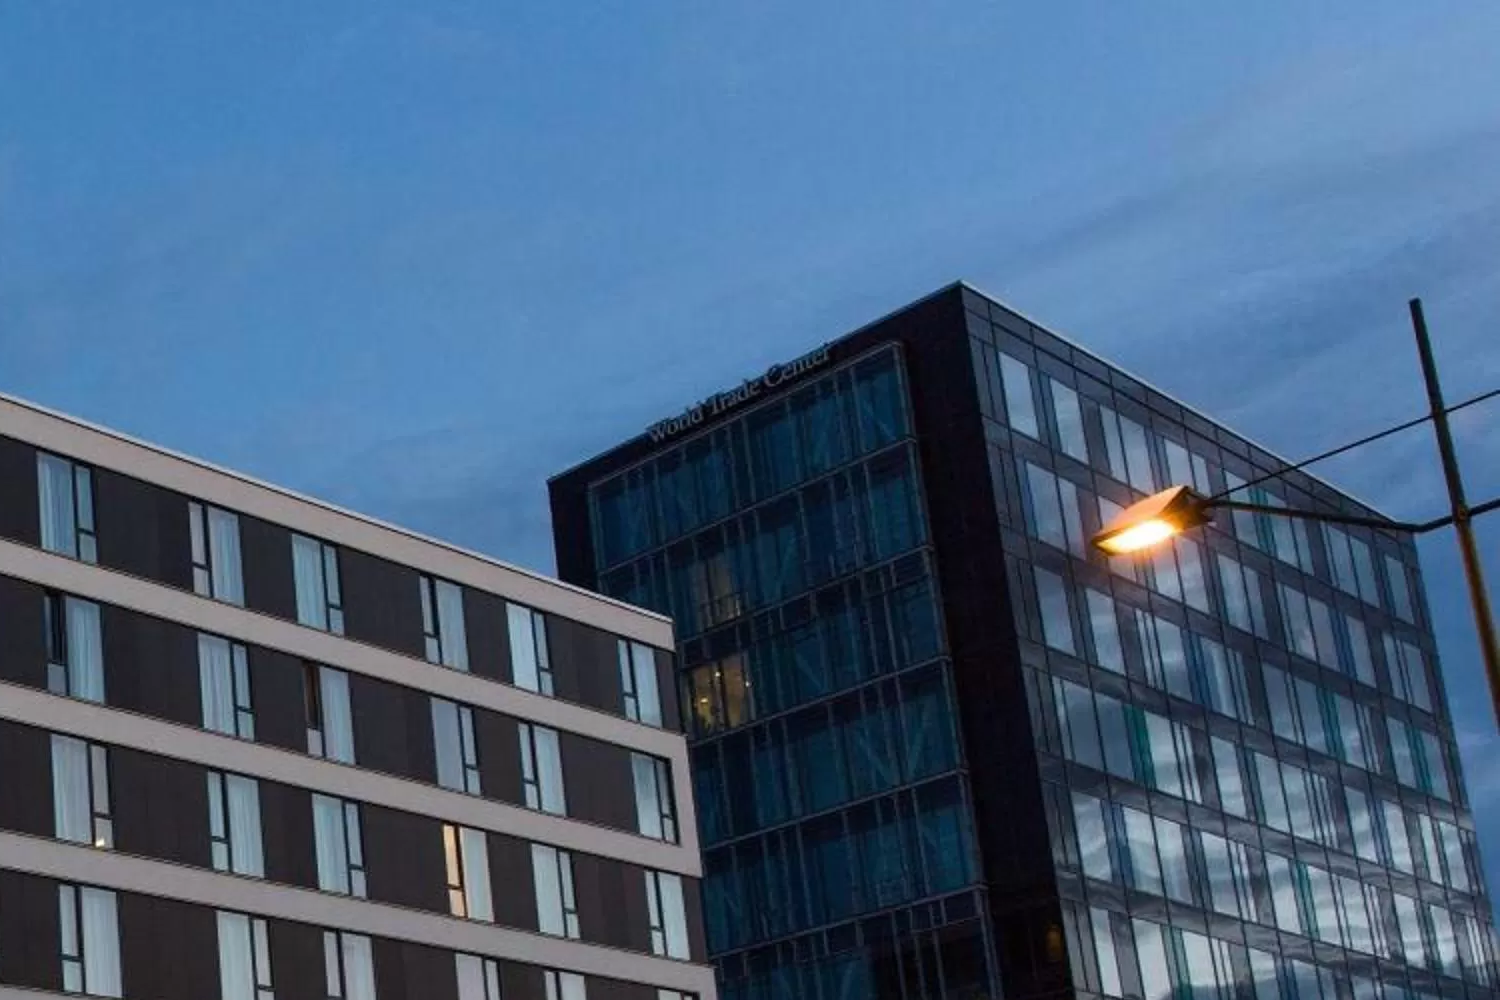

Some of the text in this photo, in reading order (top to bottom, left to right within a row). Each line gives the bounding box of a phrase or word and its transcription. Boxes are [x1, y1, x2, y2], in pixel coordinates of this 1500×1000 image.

[647, 349, 831, 443] World Trade Center
